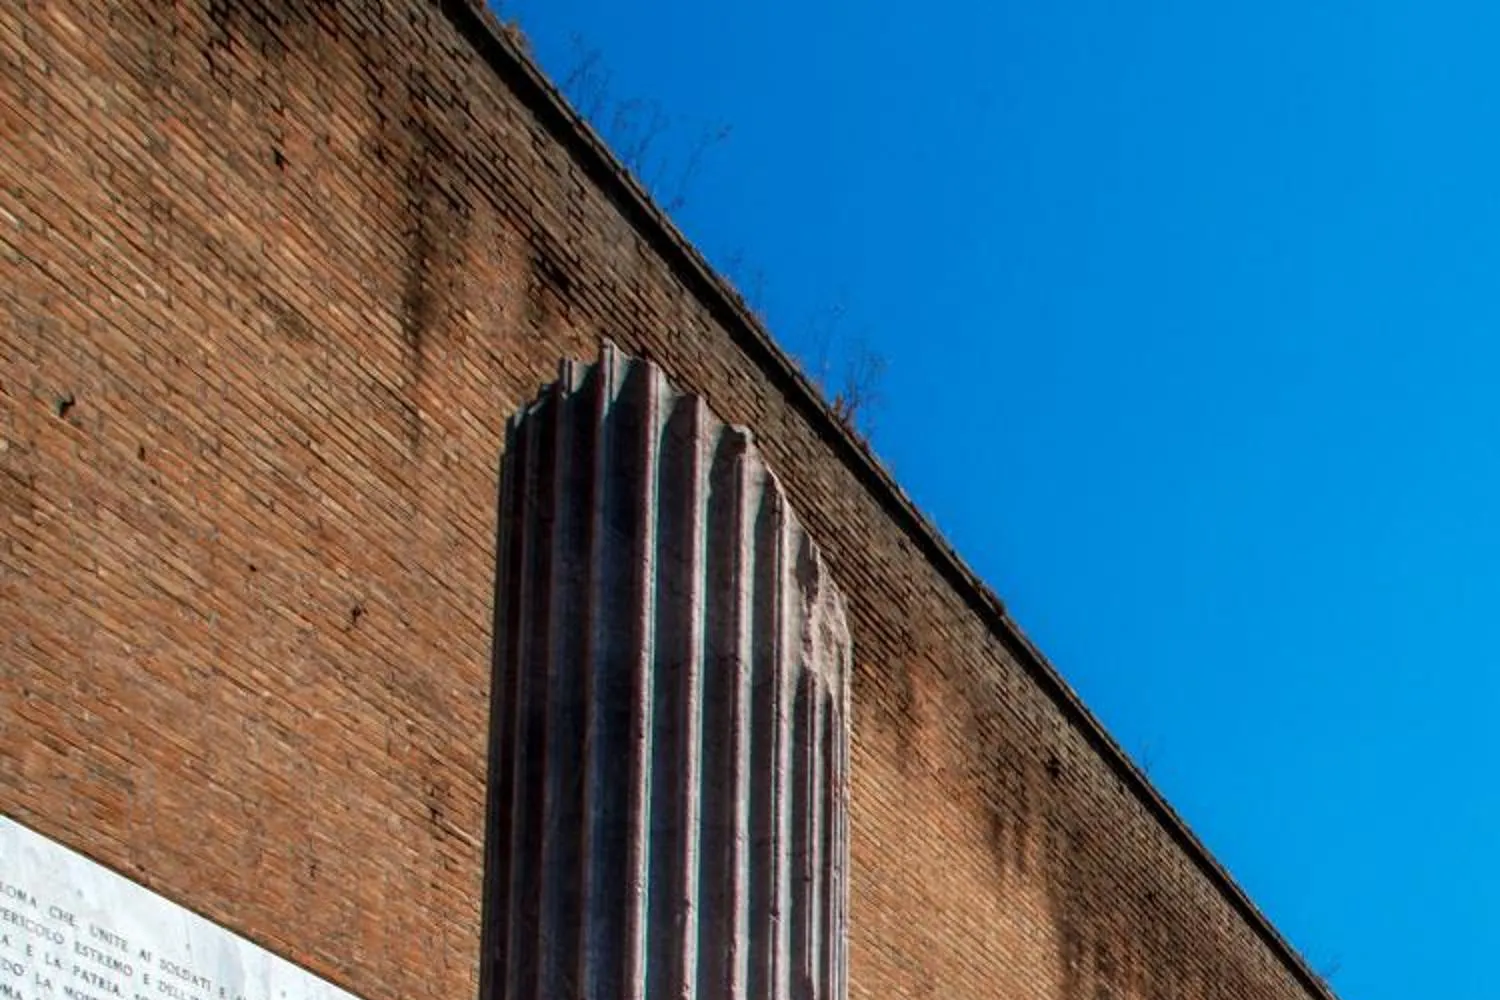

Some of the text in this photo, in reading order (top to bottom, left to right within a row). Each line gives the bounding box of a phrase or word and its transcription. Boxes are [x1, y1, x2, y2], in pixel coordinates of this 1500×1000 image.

[0, 881, 38, 908] OMA
[26, 943, 33, 957] E
[45, 951, 62, 971] LA
[35, 971, 52, 991] LA
